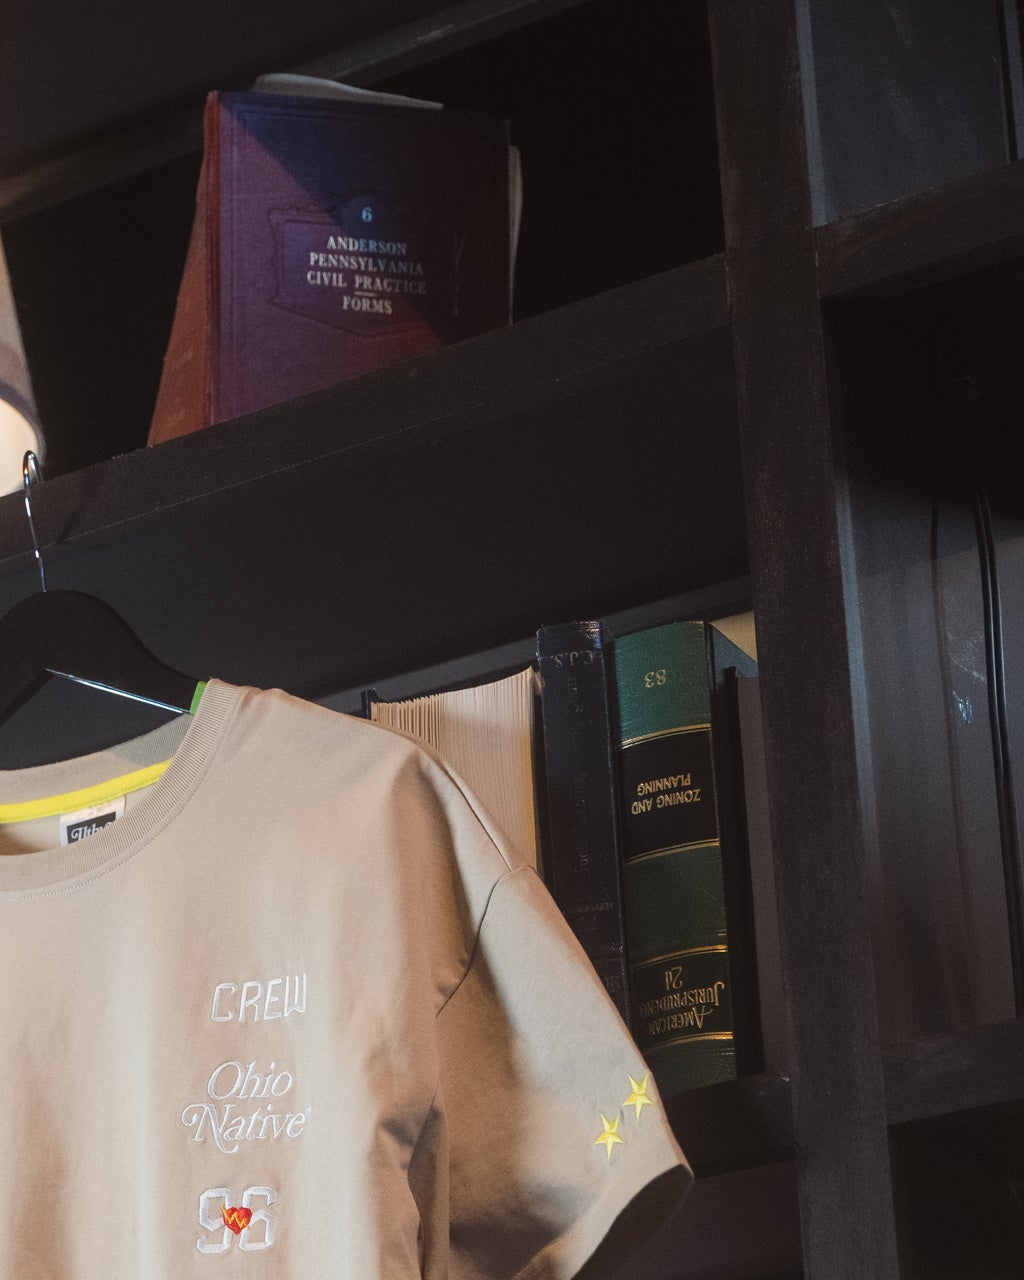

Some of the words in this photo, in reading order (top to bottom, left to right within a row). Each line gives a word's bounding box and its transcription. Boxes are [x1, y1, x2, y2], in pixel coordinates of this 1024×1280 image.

[361, 207, 373, 223] 6
[326, 235, 407, 256] ANDERSON
[309, 252, 424, 275] PENNSYLVANIA
[306, 270, 348, 288] CIVIL
[354, 275, 426, 295] PRACTICE
[342, 295, 393, 315] FORMS
[644, 668, 666, 689] 83
[637, 773, 692, 795] PLANNING
[630, 798, 654, 815] AND
[656, 789, 701, 810] ZONING
[664, 965, 683, 991] 2d
[210, 972, 307, 1023] CREW
[648, 1005, 713, 1035] AMERICAN
[207, 1060, 293, 1100] Ohio
[196, 1186, 278, 1254] 96
